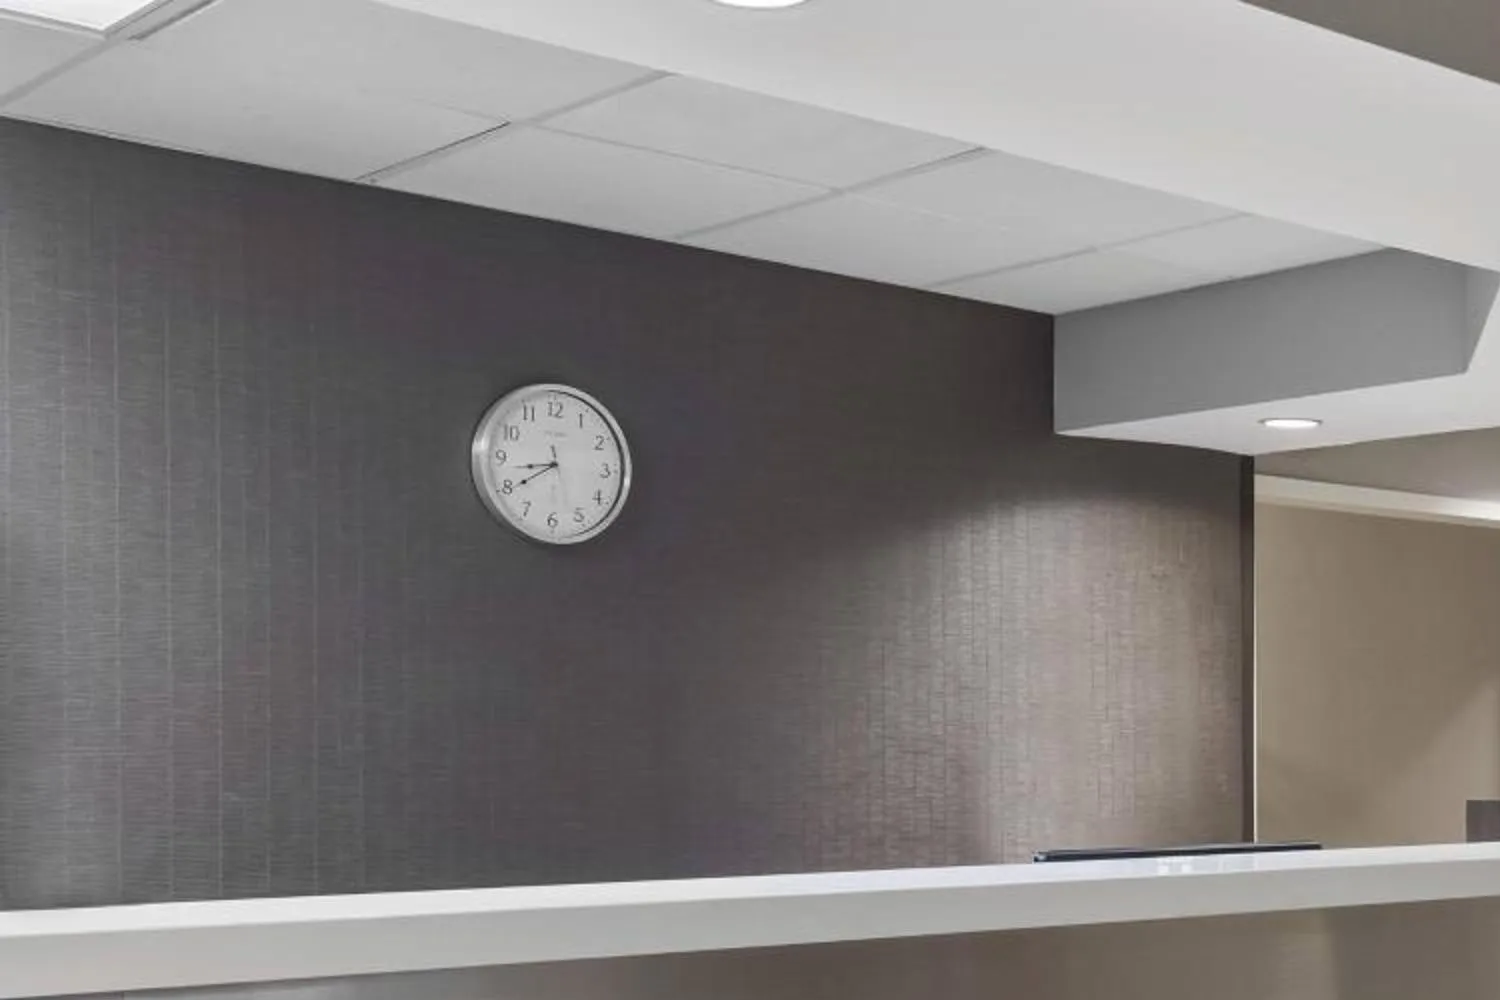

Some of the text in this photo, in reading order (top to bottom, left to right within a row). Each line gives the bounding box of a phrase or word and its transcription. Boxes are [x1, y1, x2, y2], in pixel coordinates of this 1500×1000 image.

[523, 405, 535, 422] 11
[547, 402, 563, 418] 12
[578, 413, 583, 428] 1
[503, 425, 520, 441] 10
[594, 436, 605, 451] 2
[495, 449, 507, 464] 9
[600, 464, 611, 479] 3
[501, 480, 513, 495] 8
[593, 489, 602, 505] 4
[521, 502, 531, 517] 7
[574, 508, 585, 523] 5
[547, 513, 558, 528] 6
